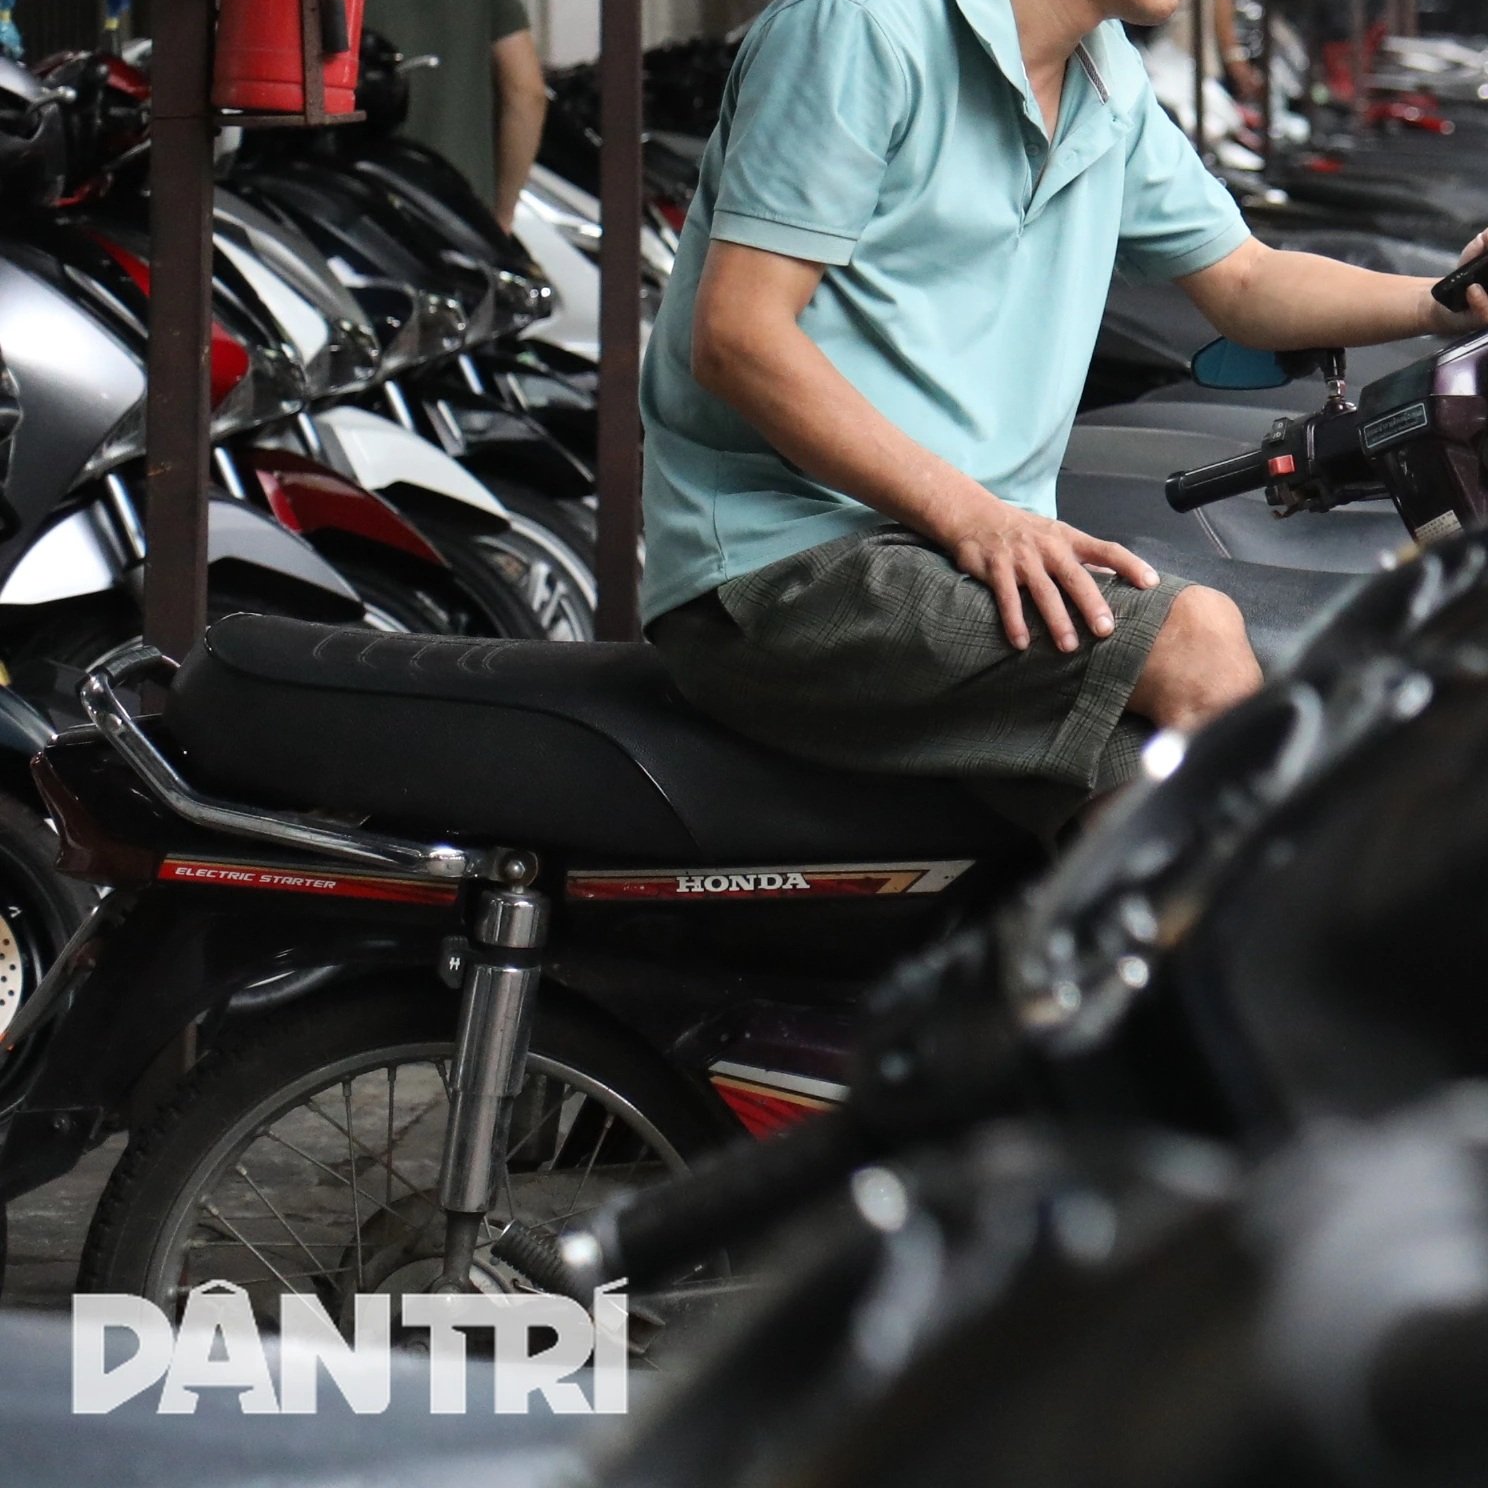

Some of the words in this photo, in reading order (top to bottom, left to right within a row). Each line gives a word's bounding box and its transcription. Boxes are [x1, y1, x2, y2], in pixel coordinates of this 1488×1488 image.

[175, 866, 256, 882] ELECTRIC
[259, 873, 337, 890] STARTER
[676, 872, 811, 893] HONDA
